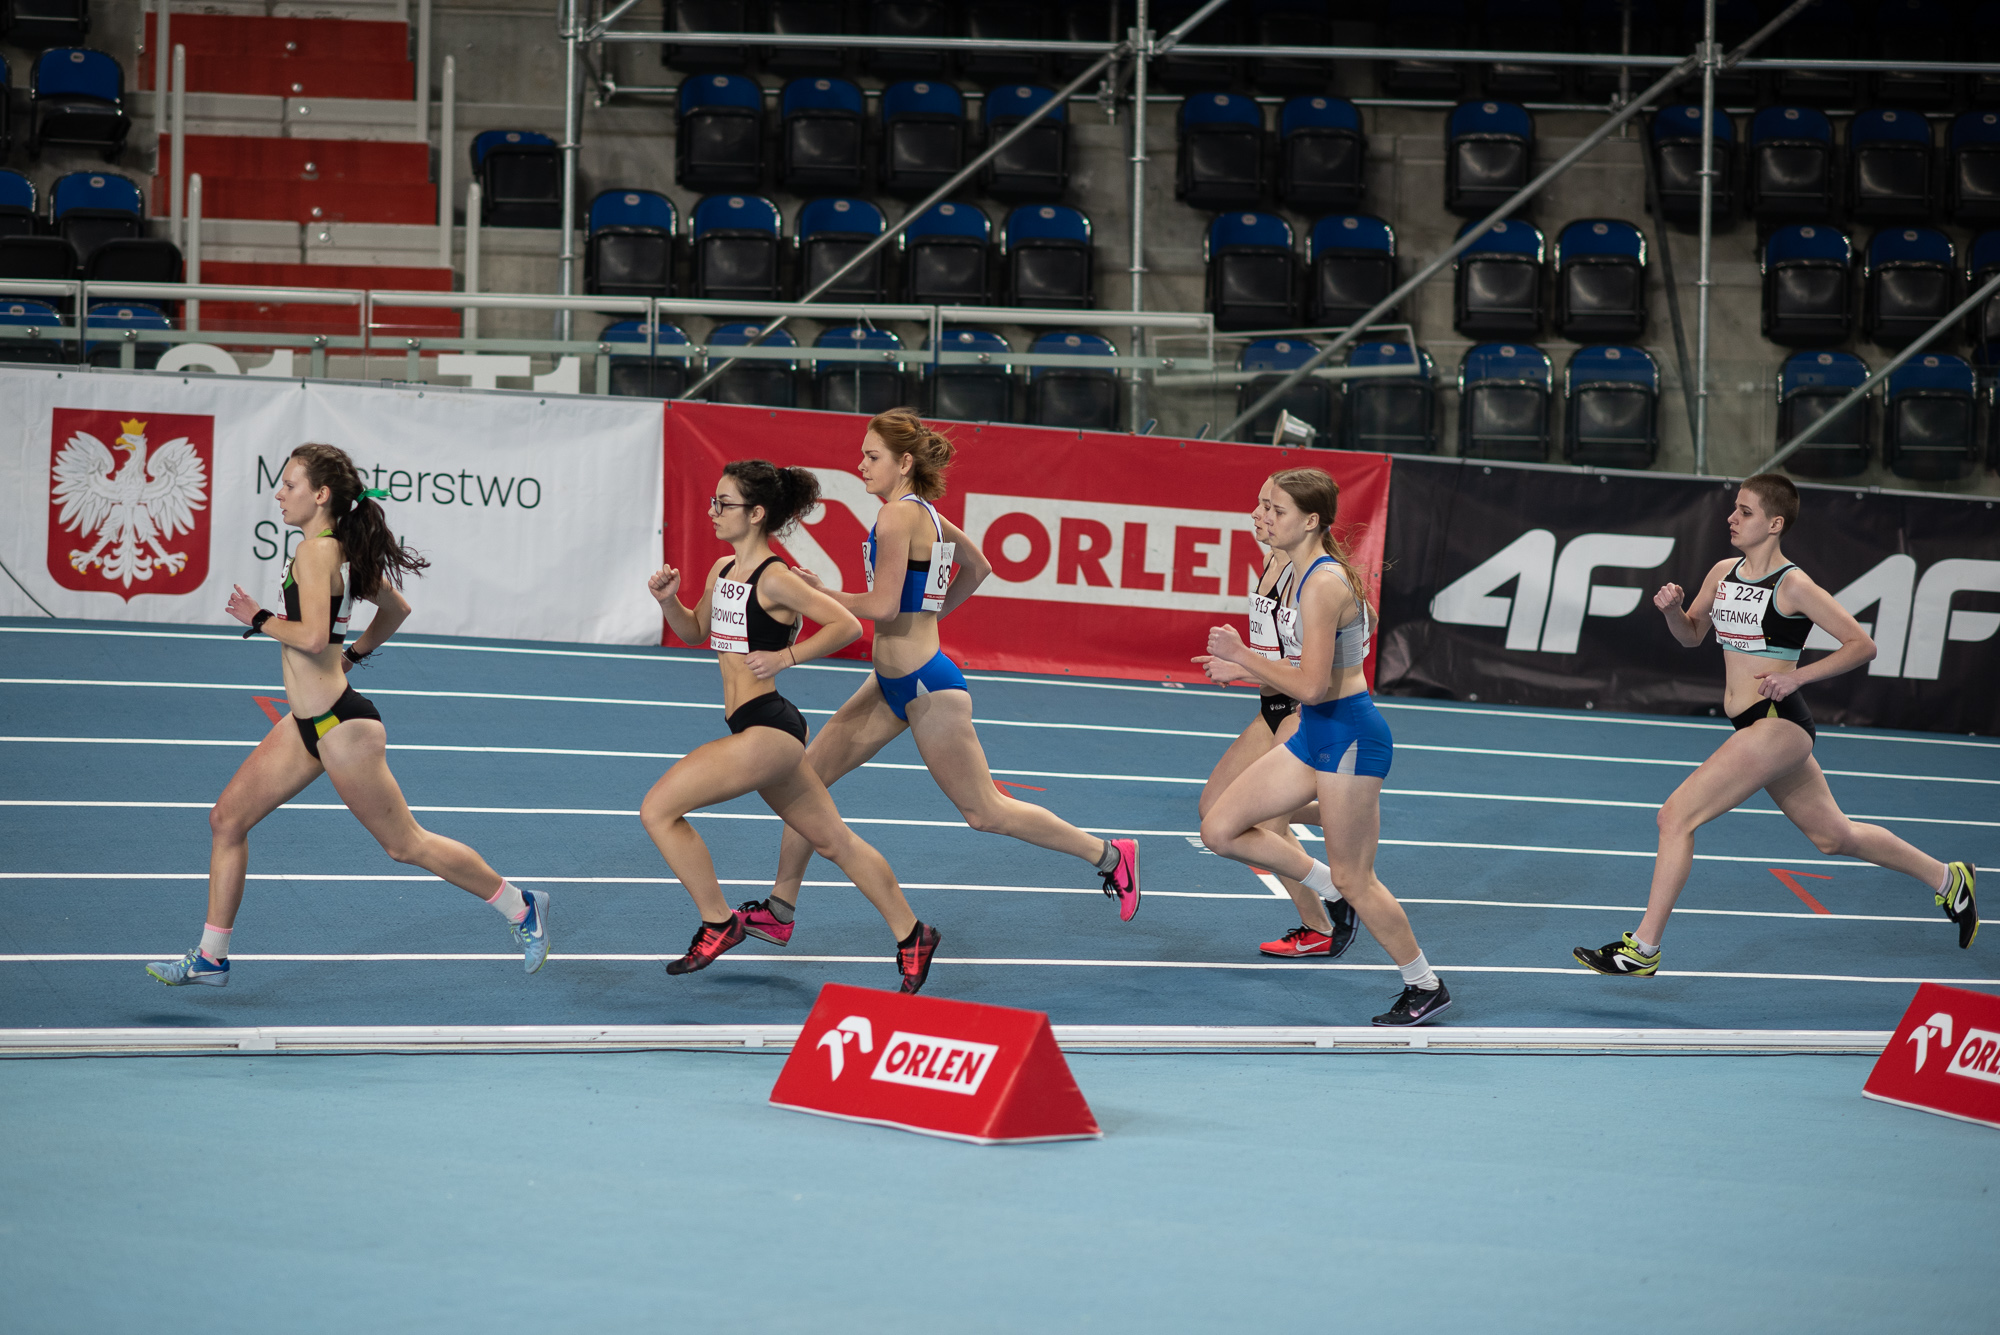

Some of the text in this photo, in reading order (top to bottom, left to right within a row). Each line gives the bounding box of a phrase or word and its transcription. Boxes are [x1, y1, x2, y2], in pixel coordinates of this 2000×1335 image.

[257, 455, 541, 509] Mterstwo
[982, 511, 1265, 597] ORLEN
[720, 582, 745, 601] 489
[1430, 529, 1676, 654] 4F
[1734, 585, 1765, 603] 224
[1255, 597, 1272, 614] 915
[1711, 608, 1759, 625] MIETANKA
[717, 640, 733, 650] 2021
[886, 1040, 987, 1085] ORLEN
